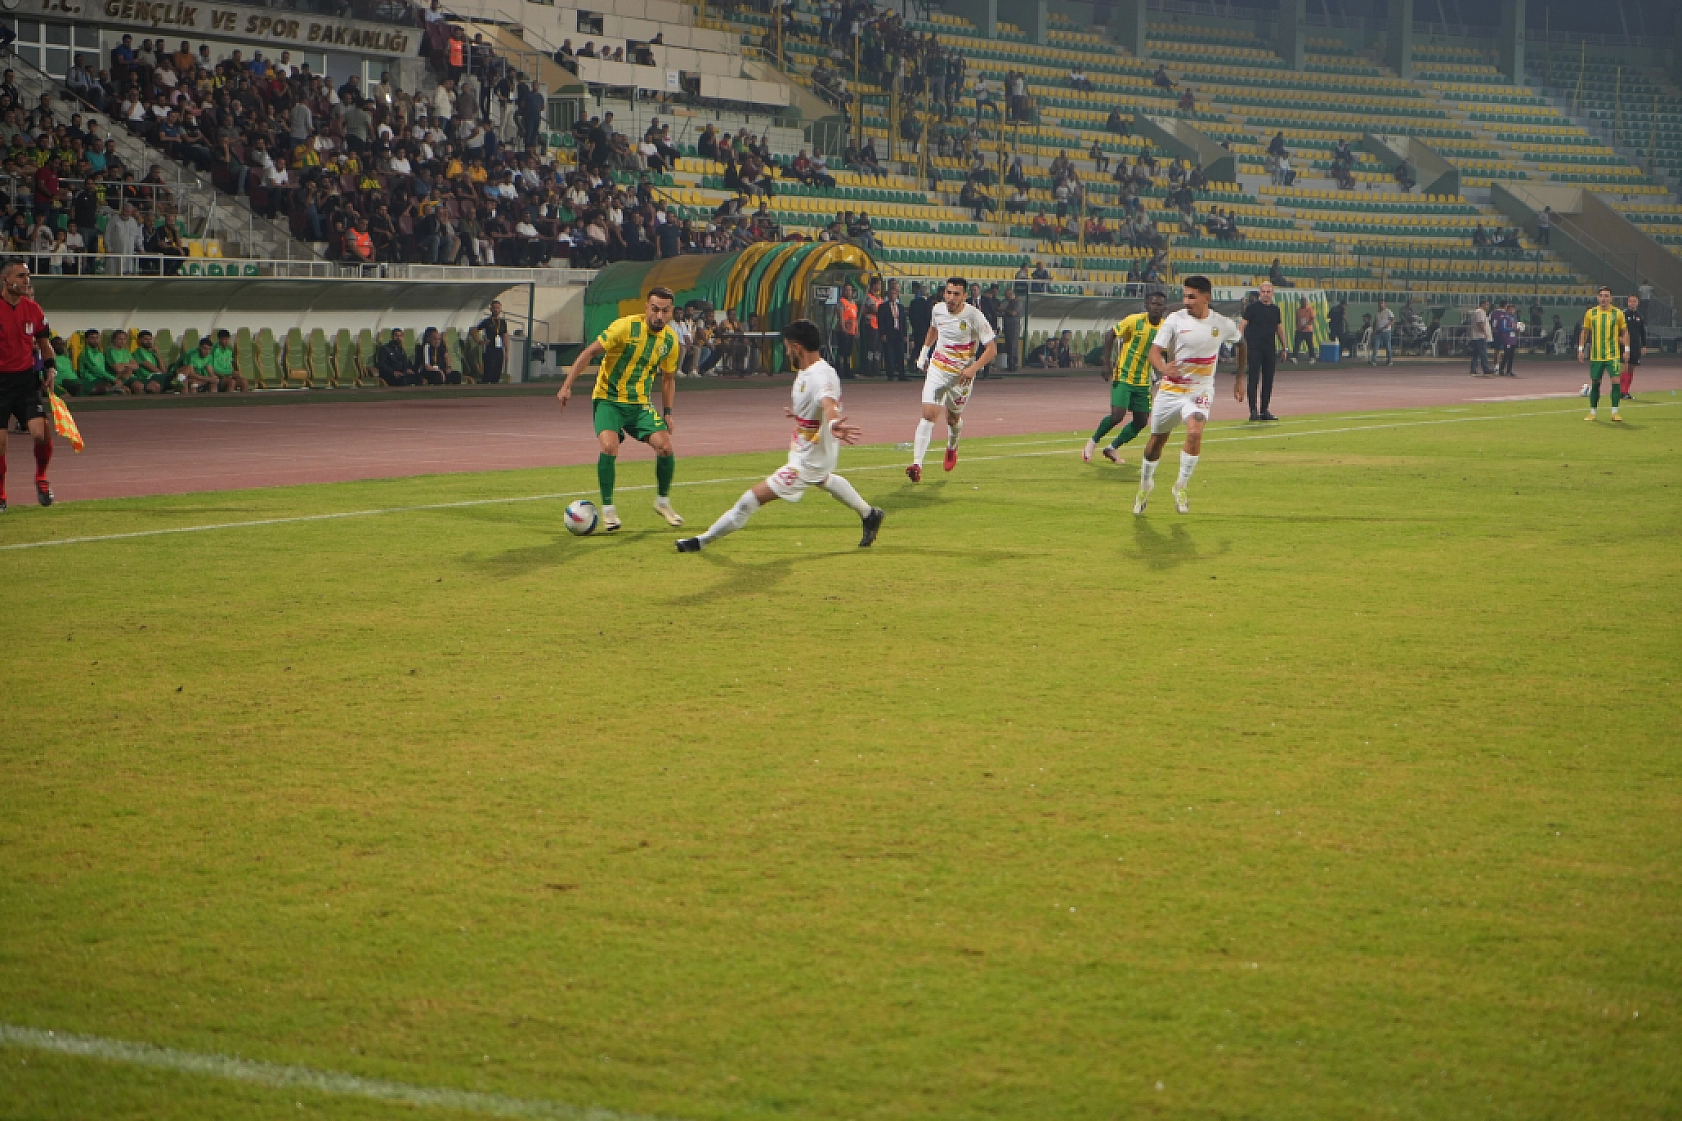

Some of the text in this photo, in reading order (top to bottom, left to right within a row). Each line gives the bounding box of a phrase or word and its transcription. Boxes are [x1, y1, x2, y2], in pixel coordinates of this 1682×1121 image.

[103, 0, 198, 27] GENÇLİK
[211, 9, 237, 31] VE
[245, 15, 300, 39] SPOR
[307, 22, 408, 52] BAKANLIĞI
